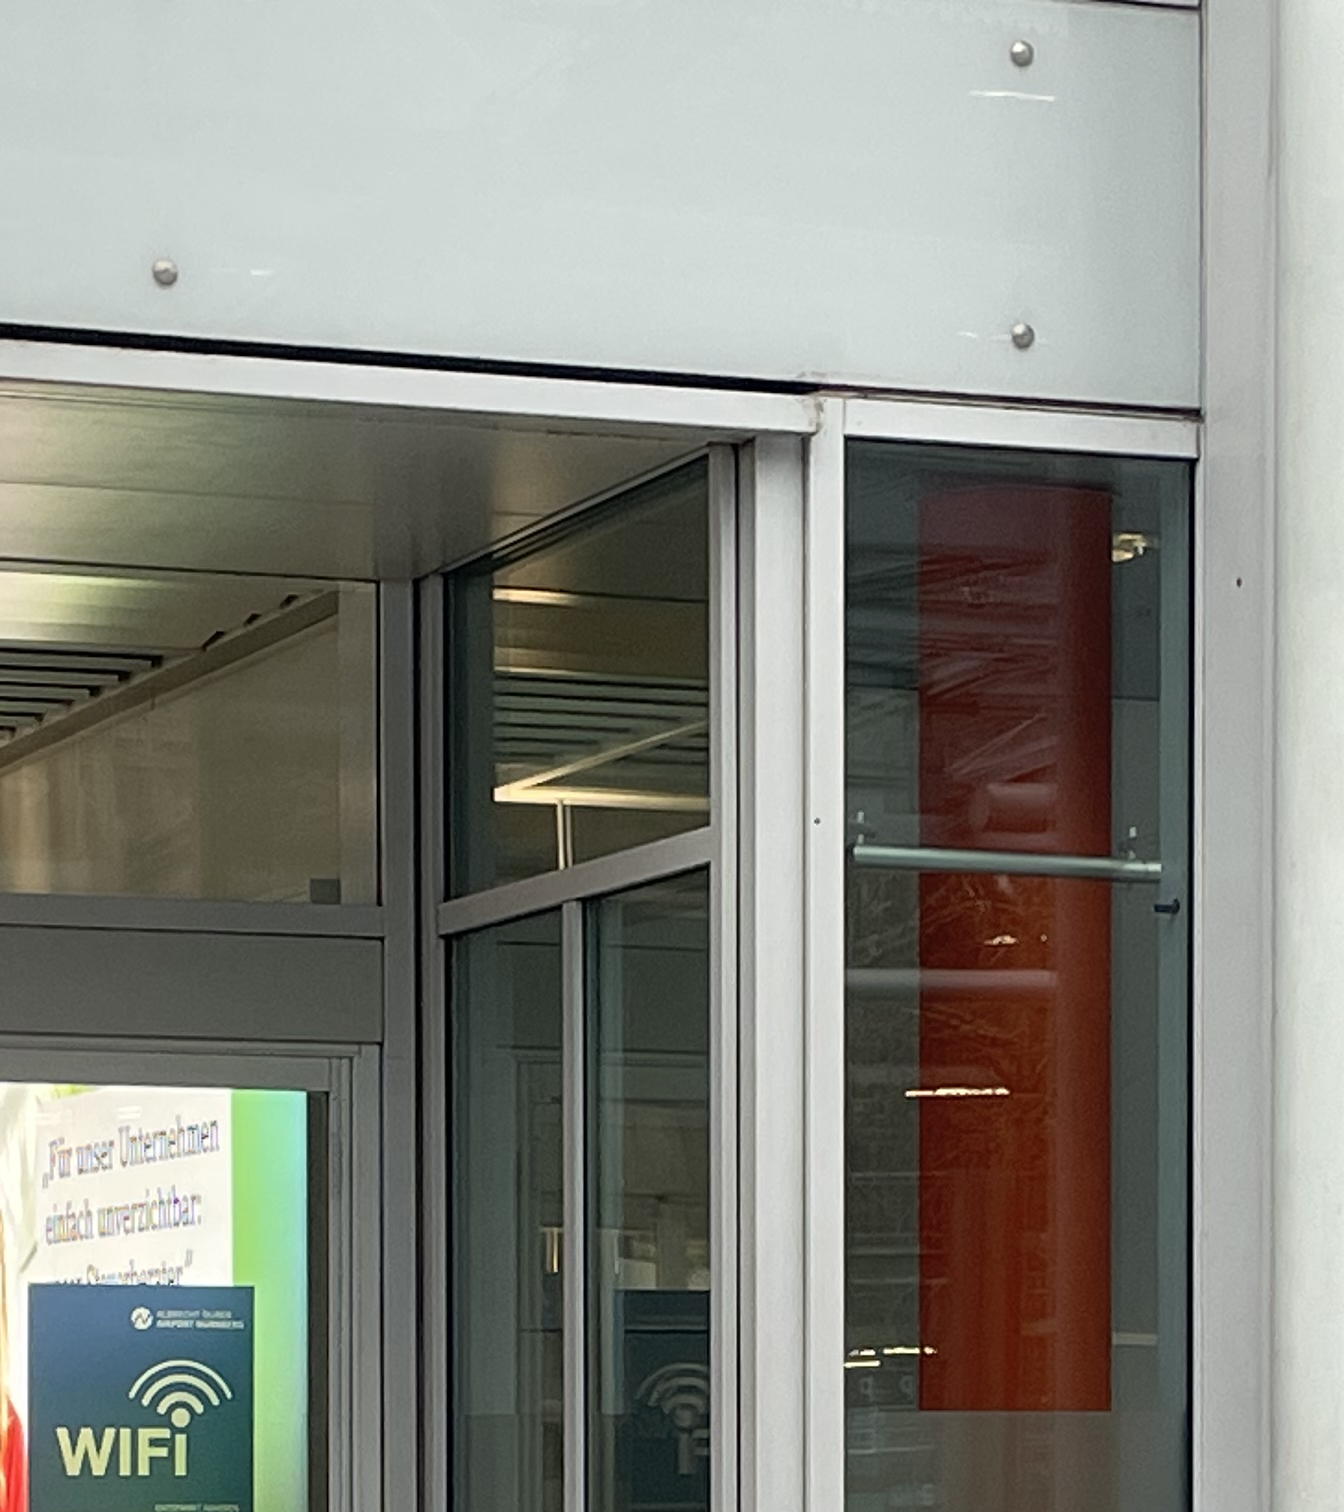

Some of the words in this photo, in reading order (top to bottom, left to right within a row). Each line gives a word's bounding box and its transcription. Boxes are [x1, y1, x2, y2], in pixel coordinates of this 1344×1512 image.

[76, 1139, 115, 1176] unser
[118, 1115, 220, 1167] Unternehmen
[45, 1199, 94, 1245] einfach
